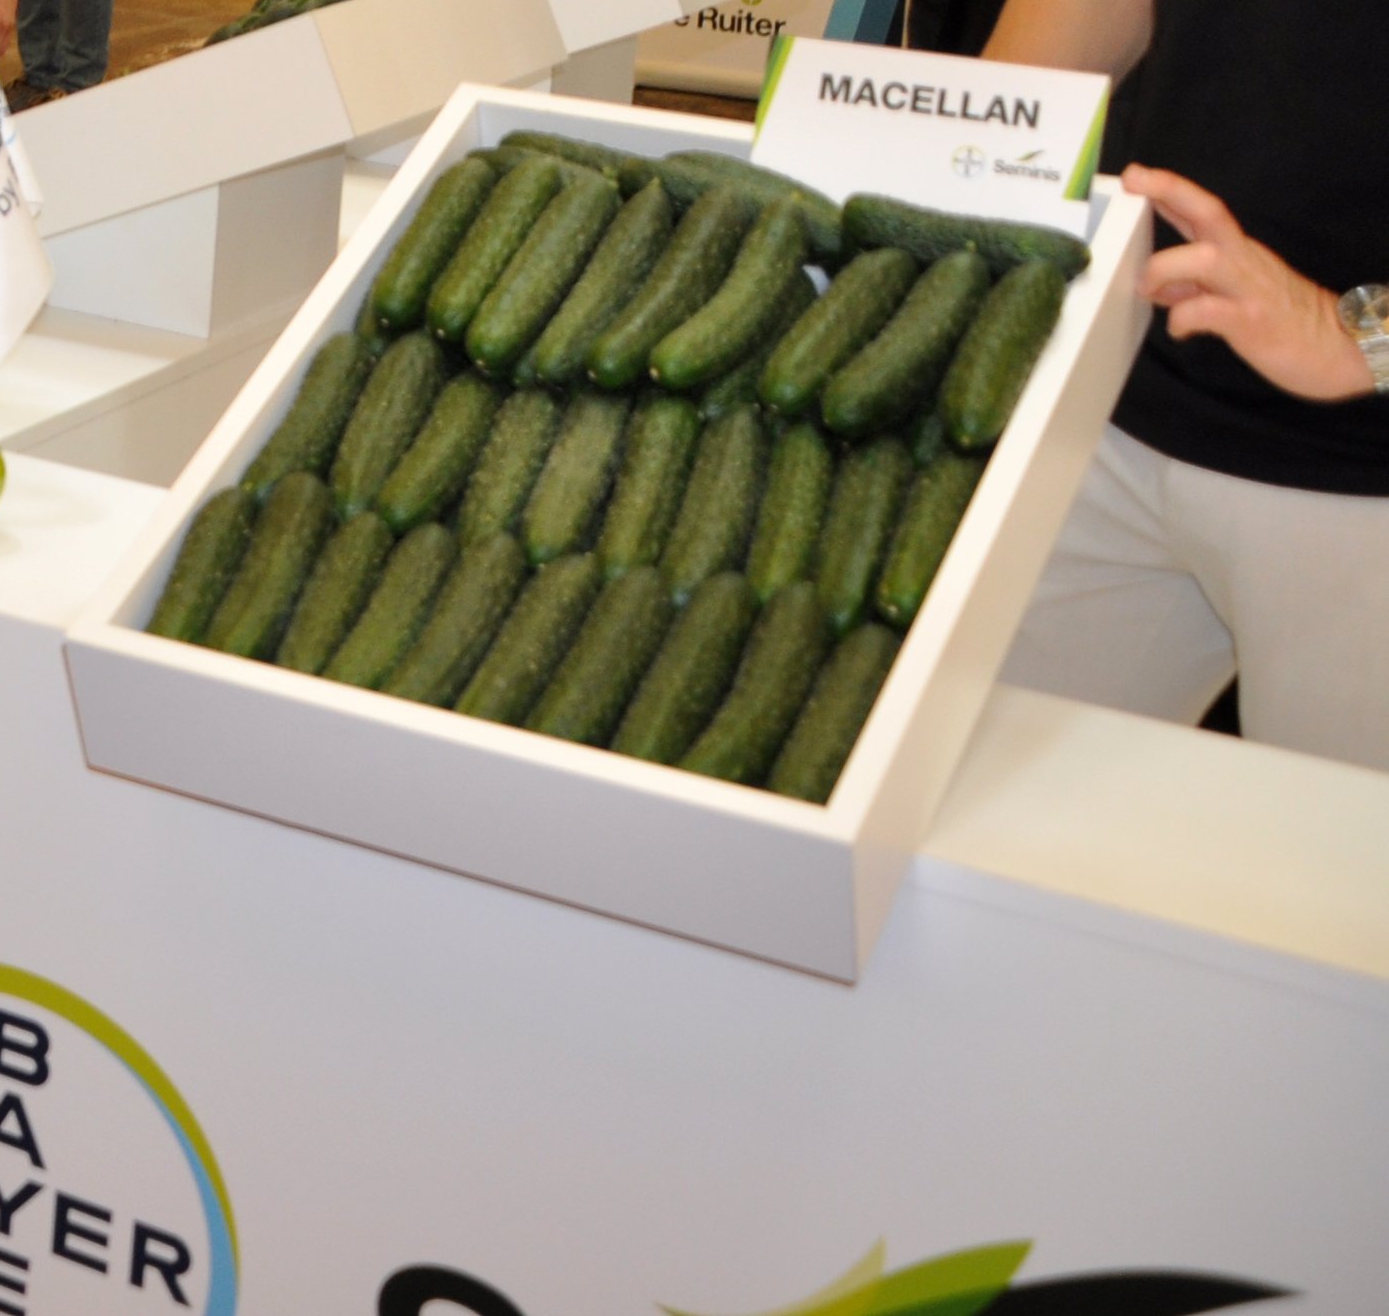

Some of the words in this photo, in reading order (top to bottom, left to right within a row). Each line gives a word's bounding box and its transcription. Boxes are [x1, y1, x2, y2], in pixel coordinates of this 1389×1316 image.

[697, 7, 787, 37] Ruiter
[818, 72, 1041, 129] MACELLAN
[993, 159, 1061, 183] Seminis
